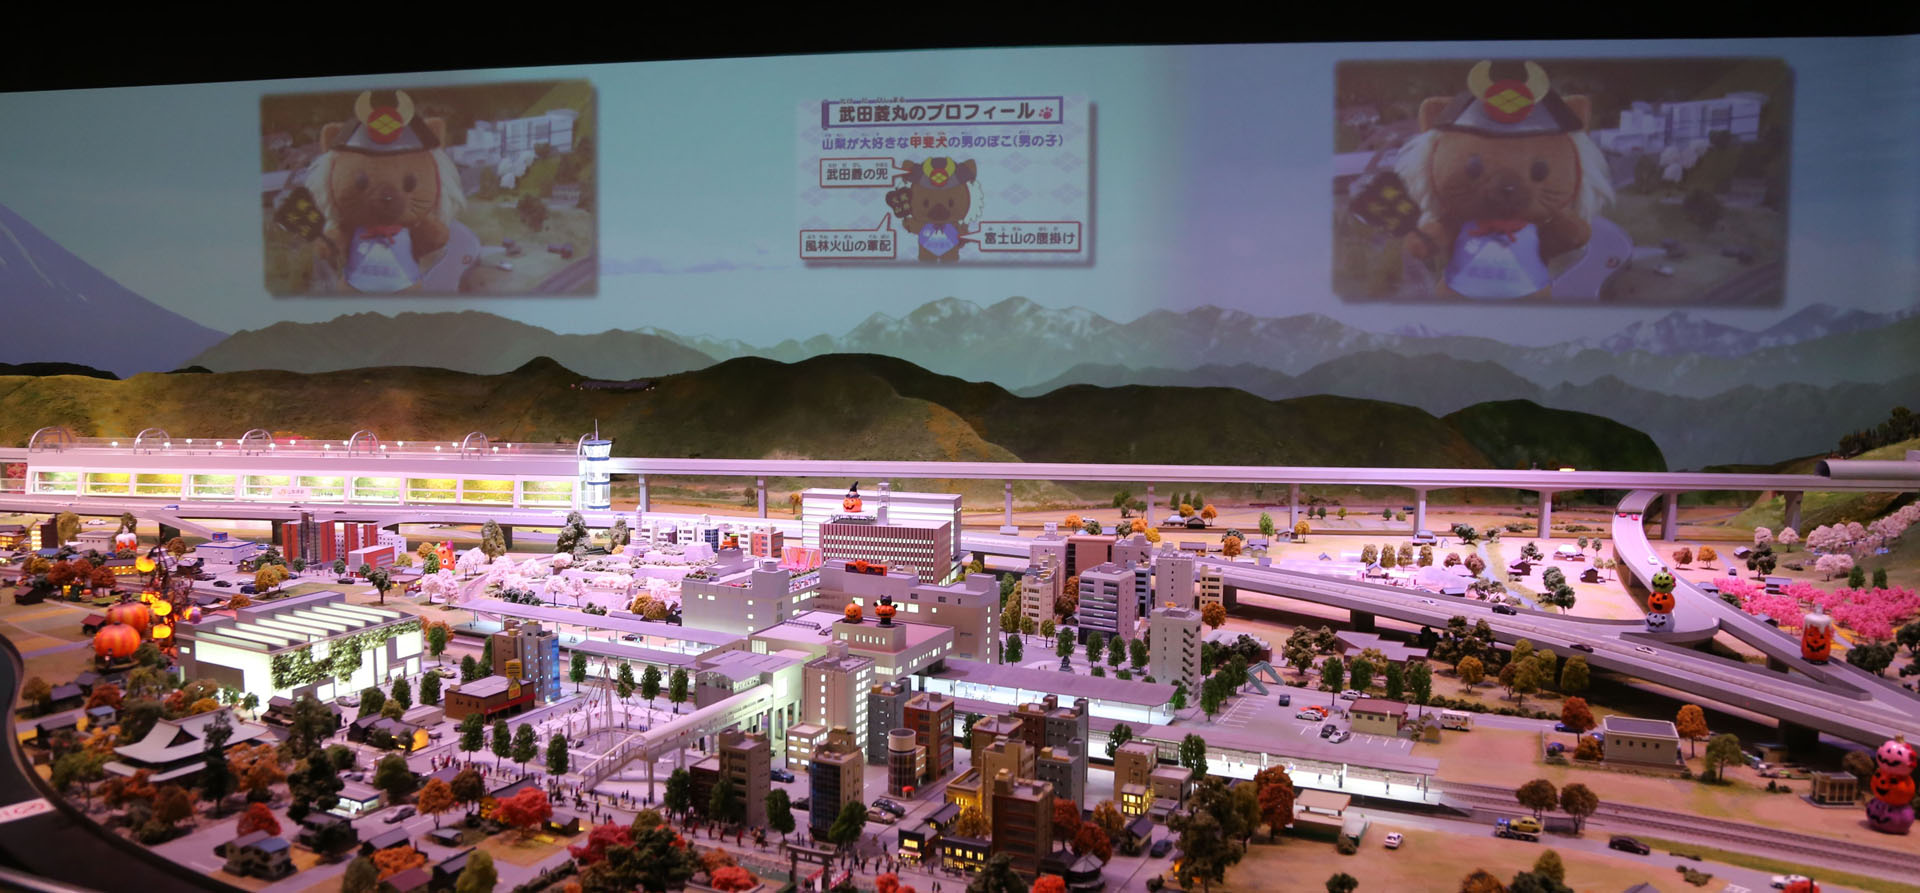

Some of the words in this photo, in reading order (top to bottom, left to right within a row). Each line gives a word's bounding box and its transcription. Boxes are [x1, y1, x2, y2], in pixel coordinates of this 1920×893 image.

[839, 102, 1035, 122] 武田菱丸のプロフィール
[805, 240, 892, 252] 風林火山の軍配
